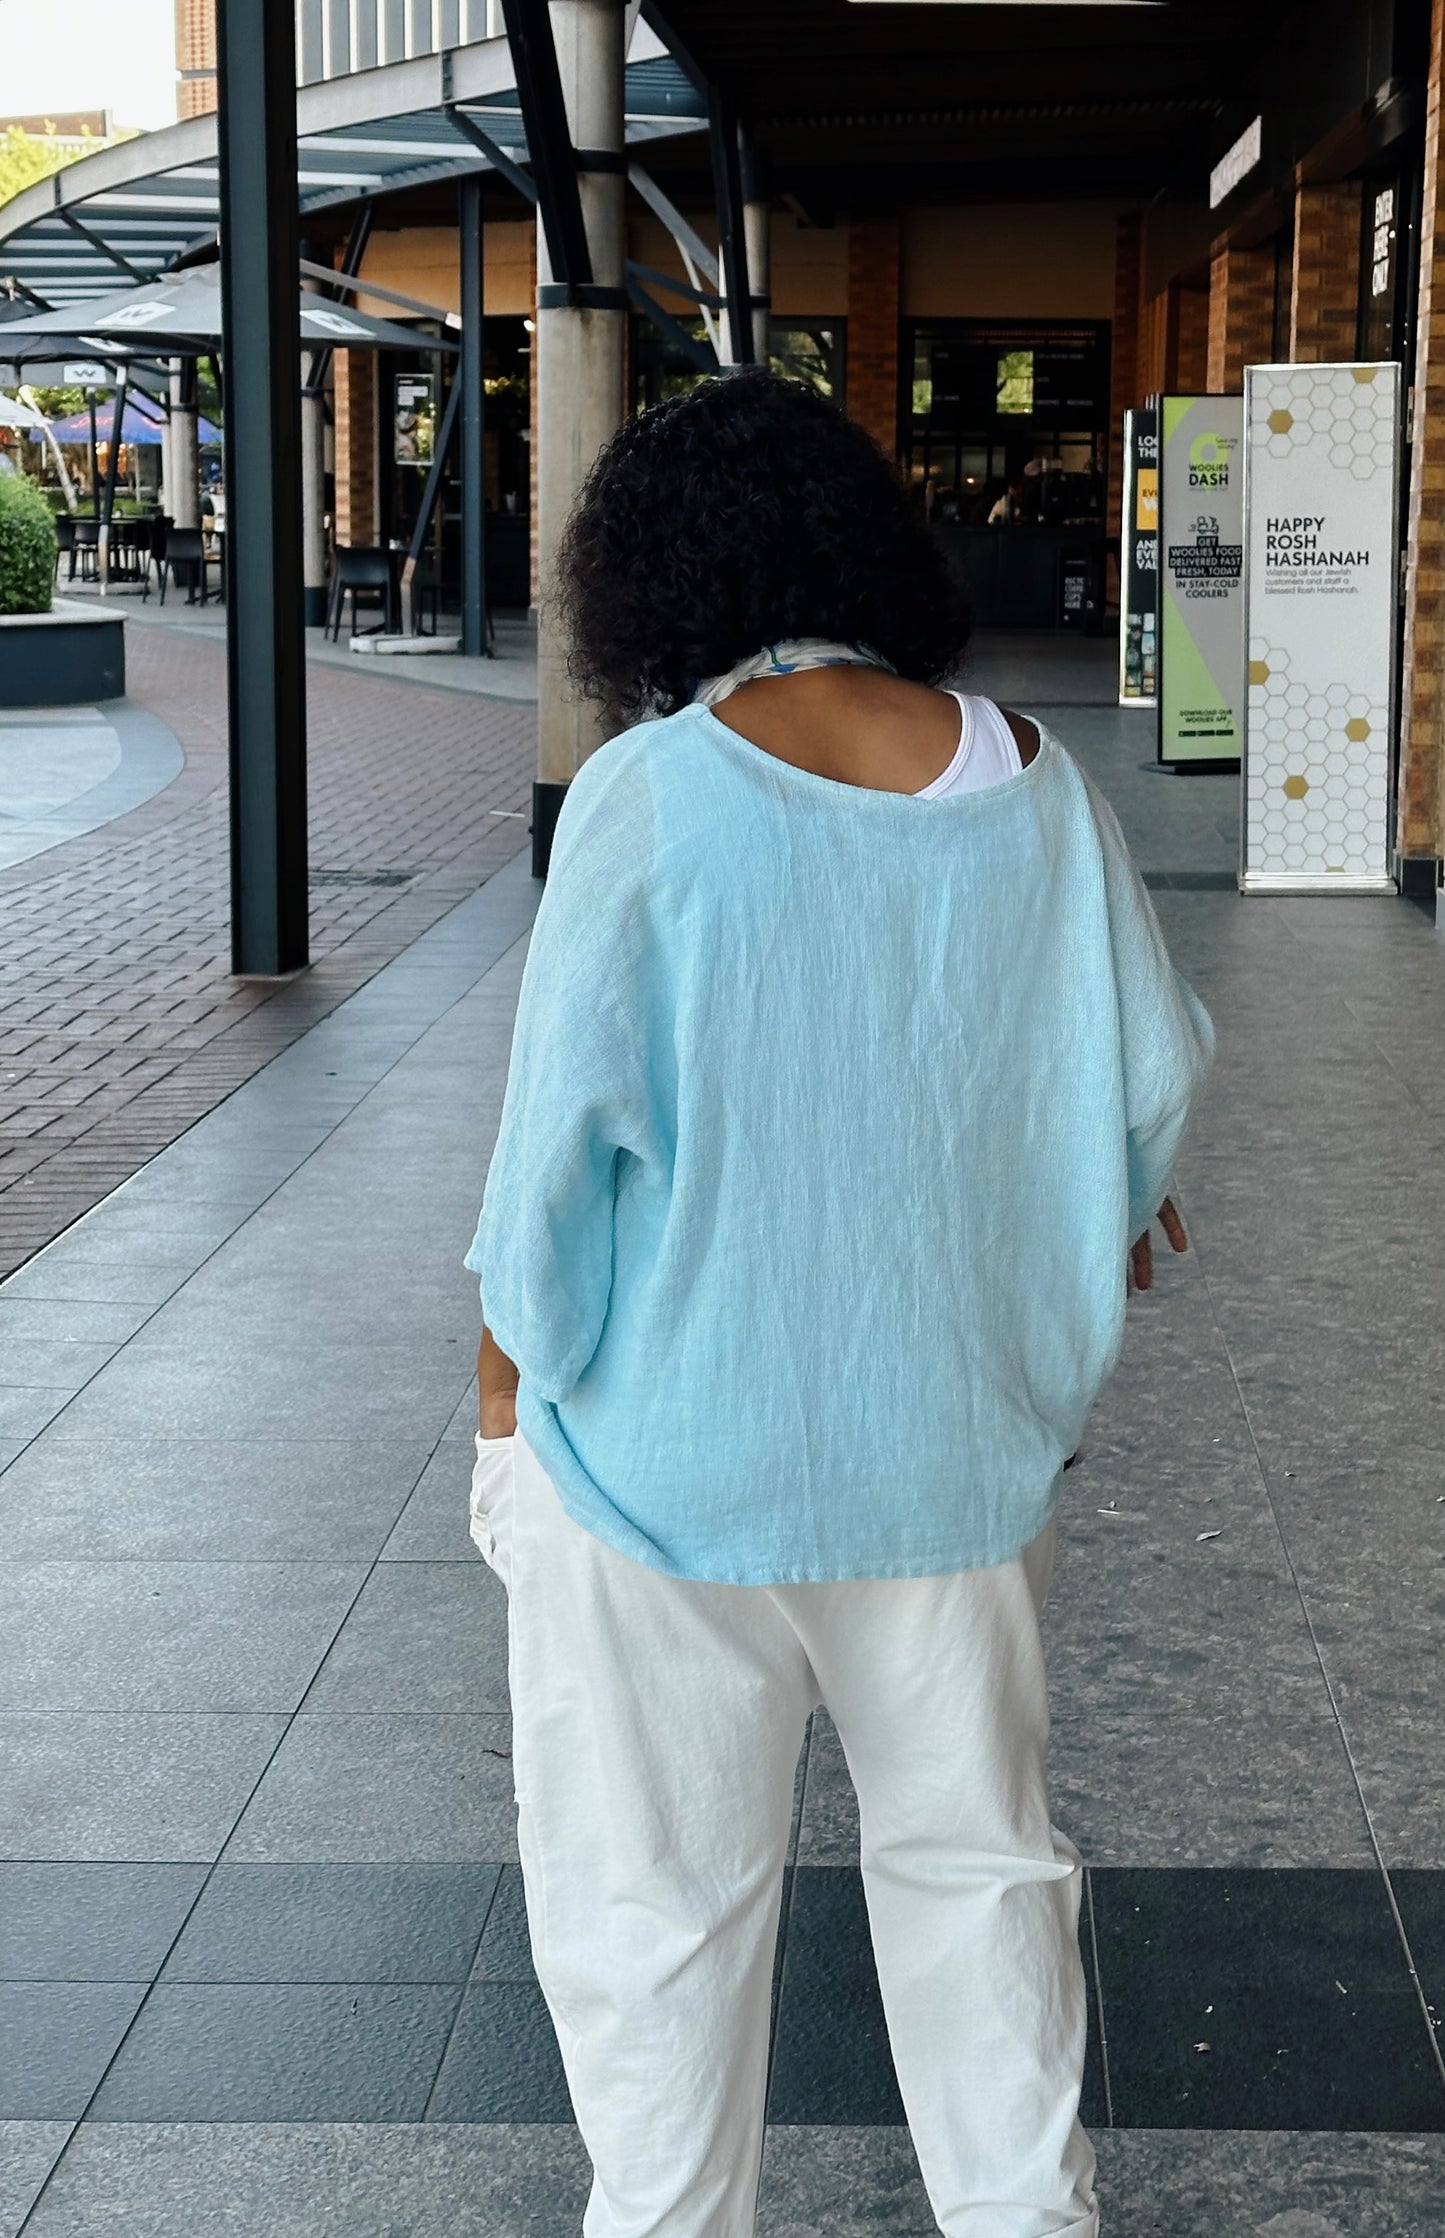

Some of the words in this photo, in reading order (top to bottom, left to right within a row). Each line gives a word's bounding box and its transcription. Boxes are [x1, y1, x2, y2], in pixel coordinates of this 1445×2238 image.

[1189, 473, 1229, 486] DASH
[1266, 517, 1326, 533] HAPPY
[1198, 538, 1216, 546] GET
[1266, 534, 1317, 550] ROSH
[1171, 548, 1213, 557] WOOLIES
[1215, 547, 1242, 556] FOOD
[1170, 557, 1218, 567] DELIVERED
[1220, 557, 1241, 566] FAST
[1266, 551, 1370, 567] HASHANAH
[1208, 567, 1238, 576] TODAY
[1265, 569, 1297, 578] Wishing
[1299, 568, 1308, 576] all
[1325, 568, 1352, 576] Jewish
[1176, 580, 1186, 588] IN
[1189, 579, 1239, 588] STAY-COLD
[1265, 578, 1304, 586] customers
[1305, 577, 1322, 585] and
[1324, 577, 1341, 585] staff
[1185, 589, 1229, 598] COOLERS
[1297, 586, 1316, 594] Rosh
